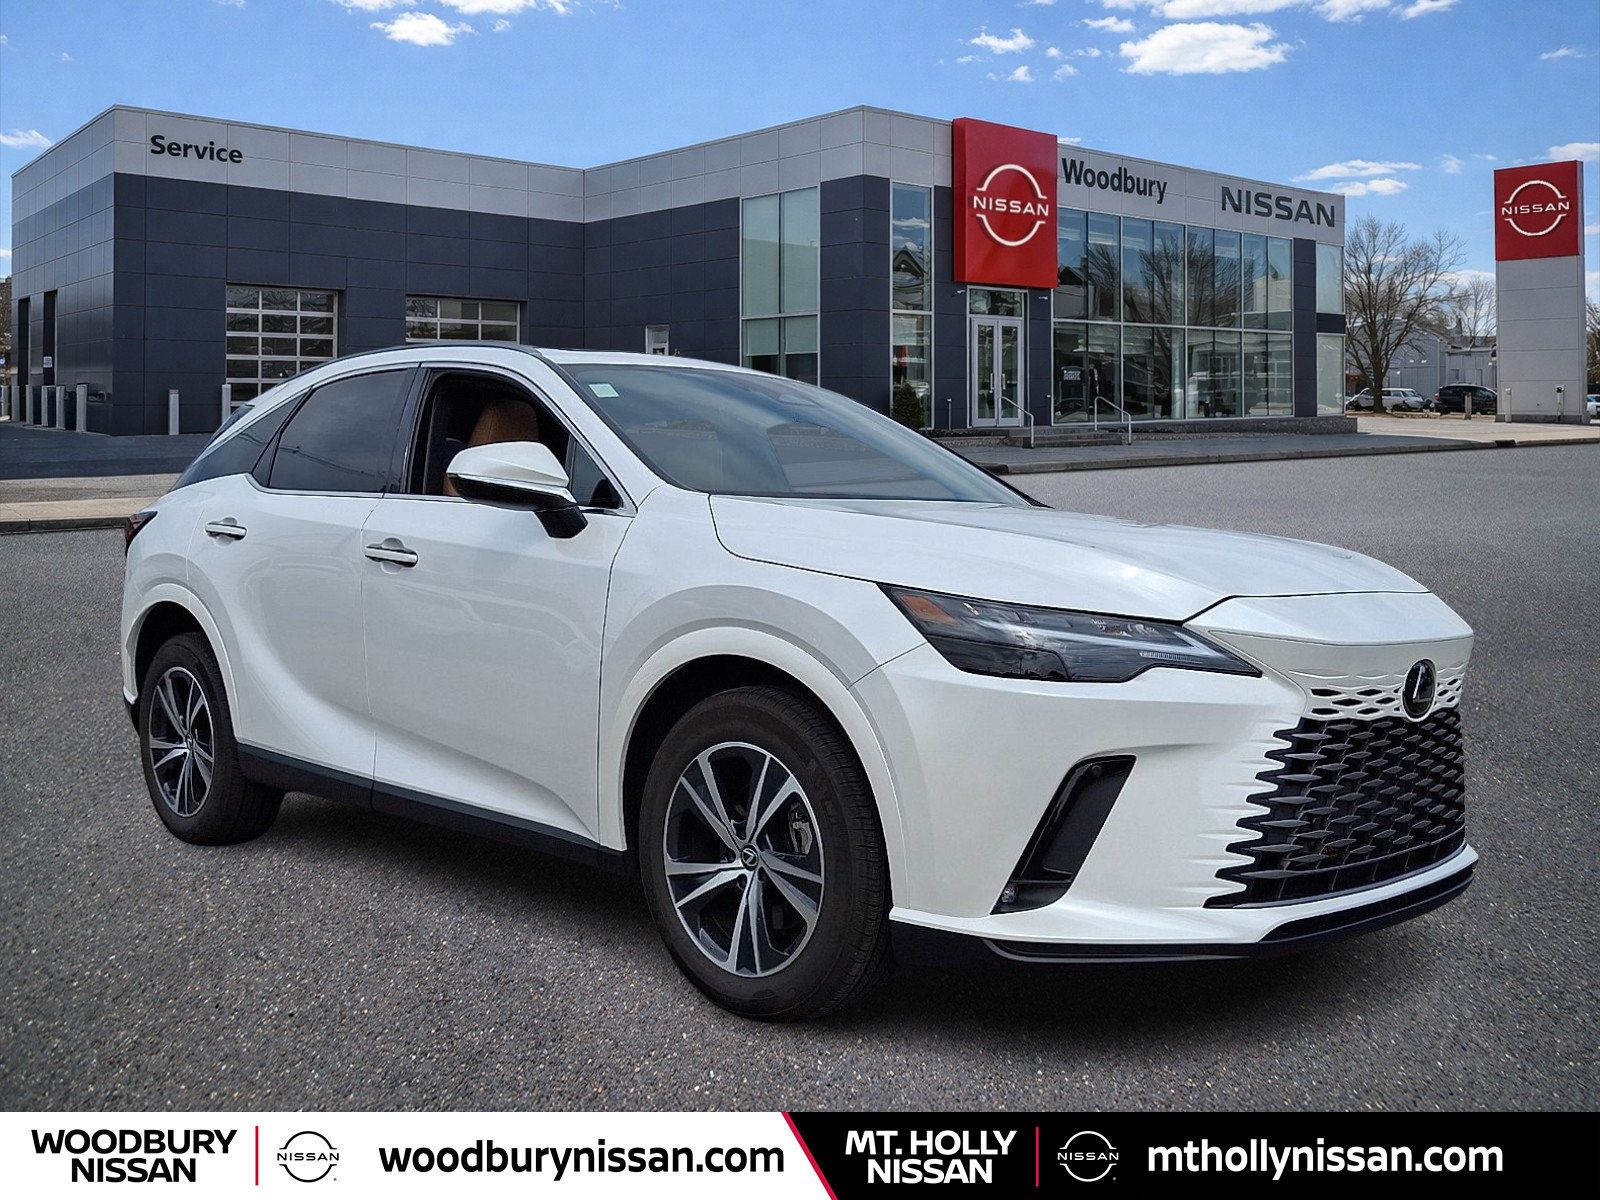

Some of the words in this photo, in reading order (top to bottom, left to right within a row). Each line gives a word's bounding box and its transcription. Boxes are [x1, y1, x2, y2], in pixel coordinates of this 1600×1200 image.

[150, 134, 243, 163] Service
[1062, 157, 1167, 204] Woodbury
[973, 195, 1049, 217] NISSAN
[1221, 186, 1335, 228] NISSAN
[1501, 201, 1570, 215] NISSAN
